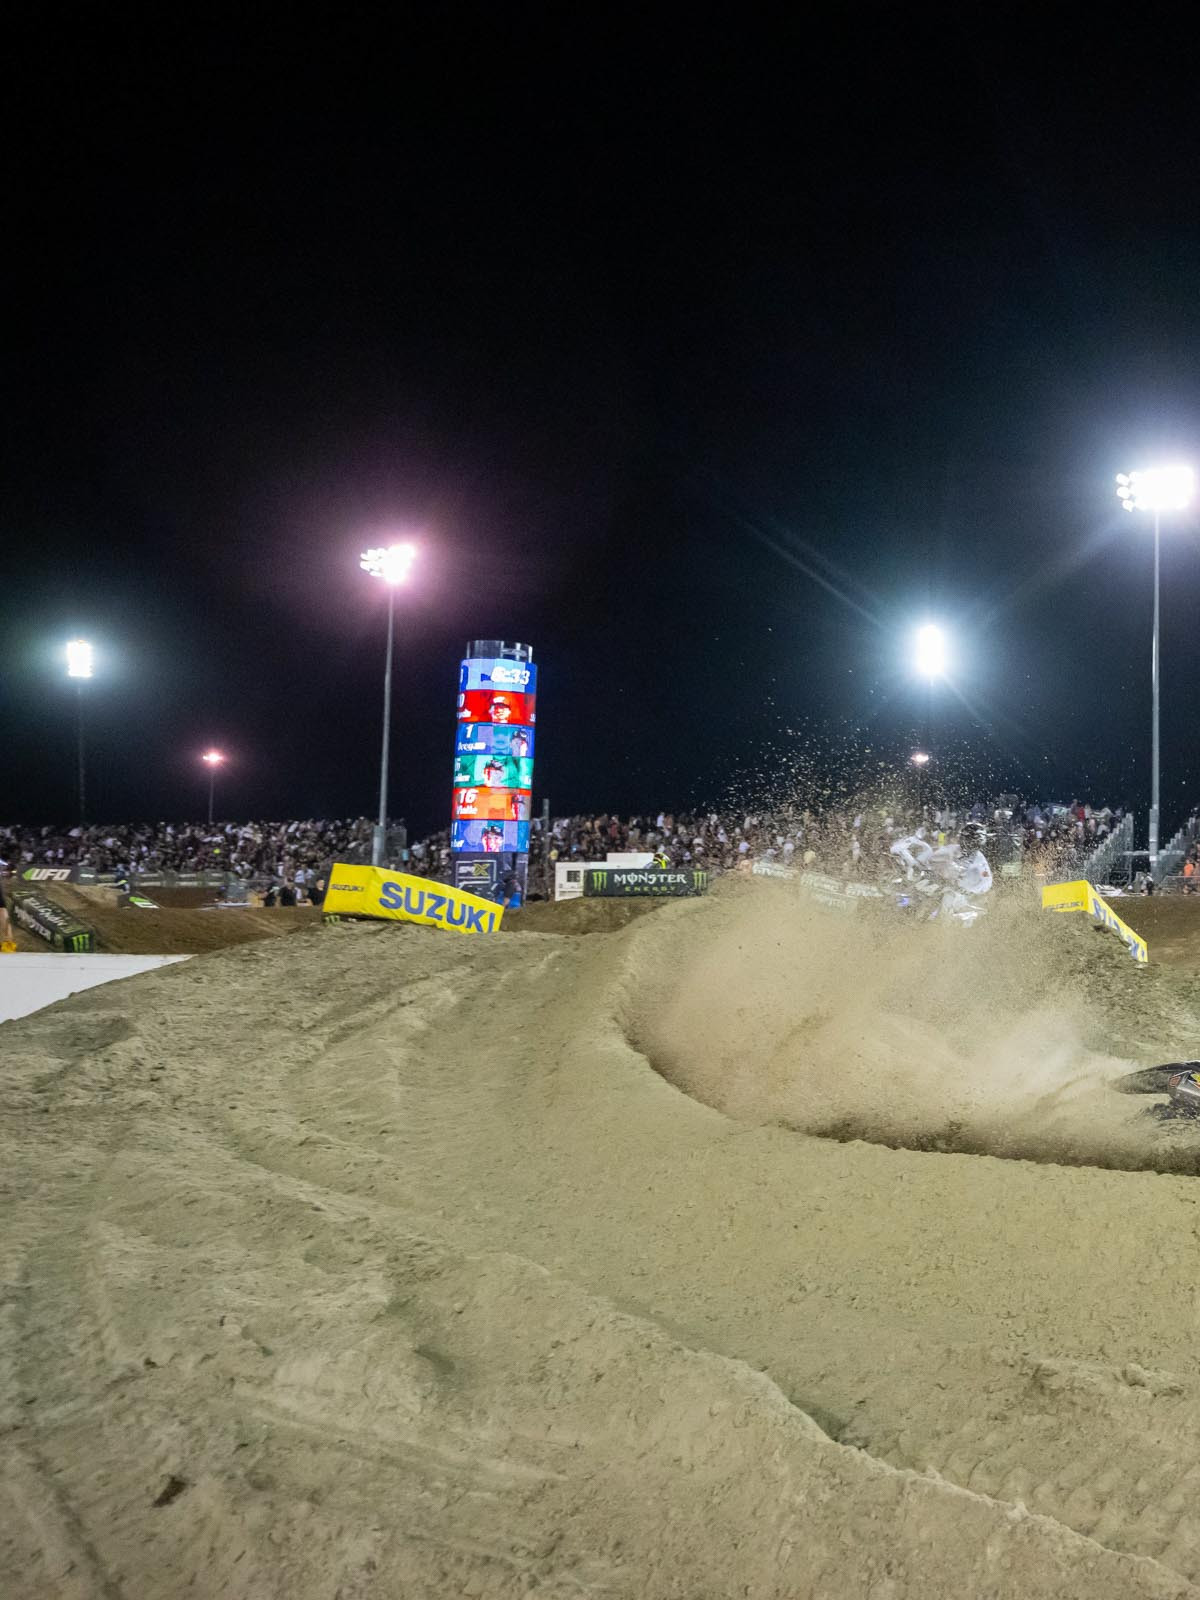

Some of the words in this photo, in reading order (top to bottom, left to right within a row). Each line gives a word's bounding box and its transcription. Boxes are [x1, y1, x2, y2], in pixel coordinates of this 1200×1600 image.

[459, 789, 479, 804] 16
[30, 869, 71, 880] UFO
[614, 872, 687, 885] MONSTER
[332, 884, 364, 892] SUZUKI
[378, 881, 496, 934] SUZUKI
